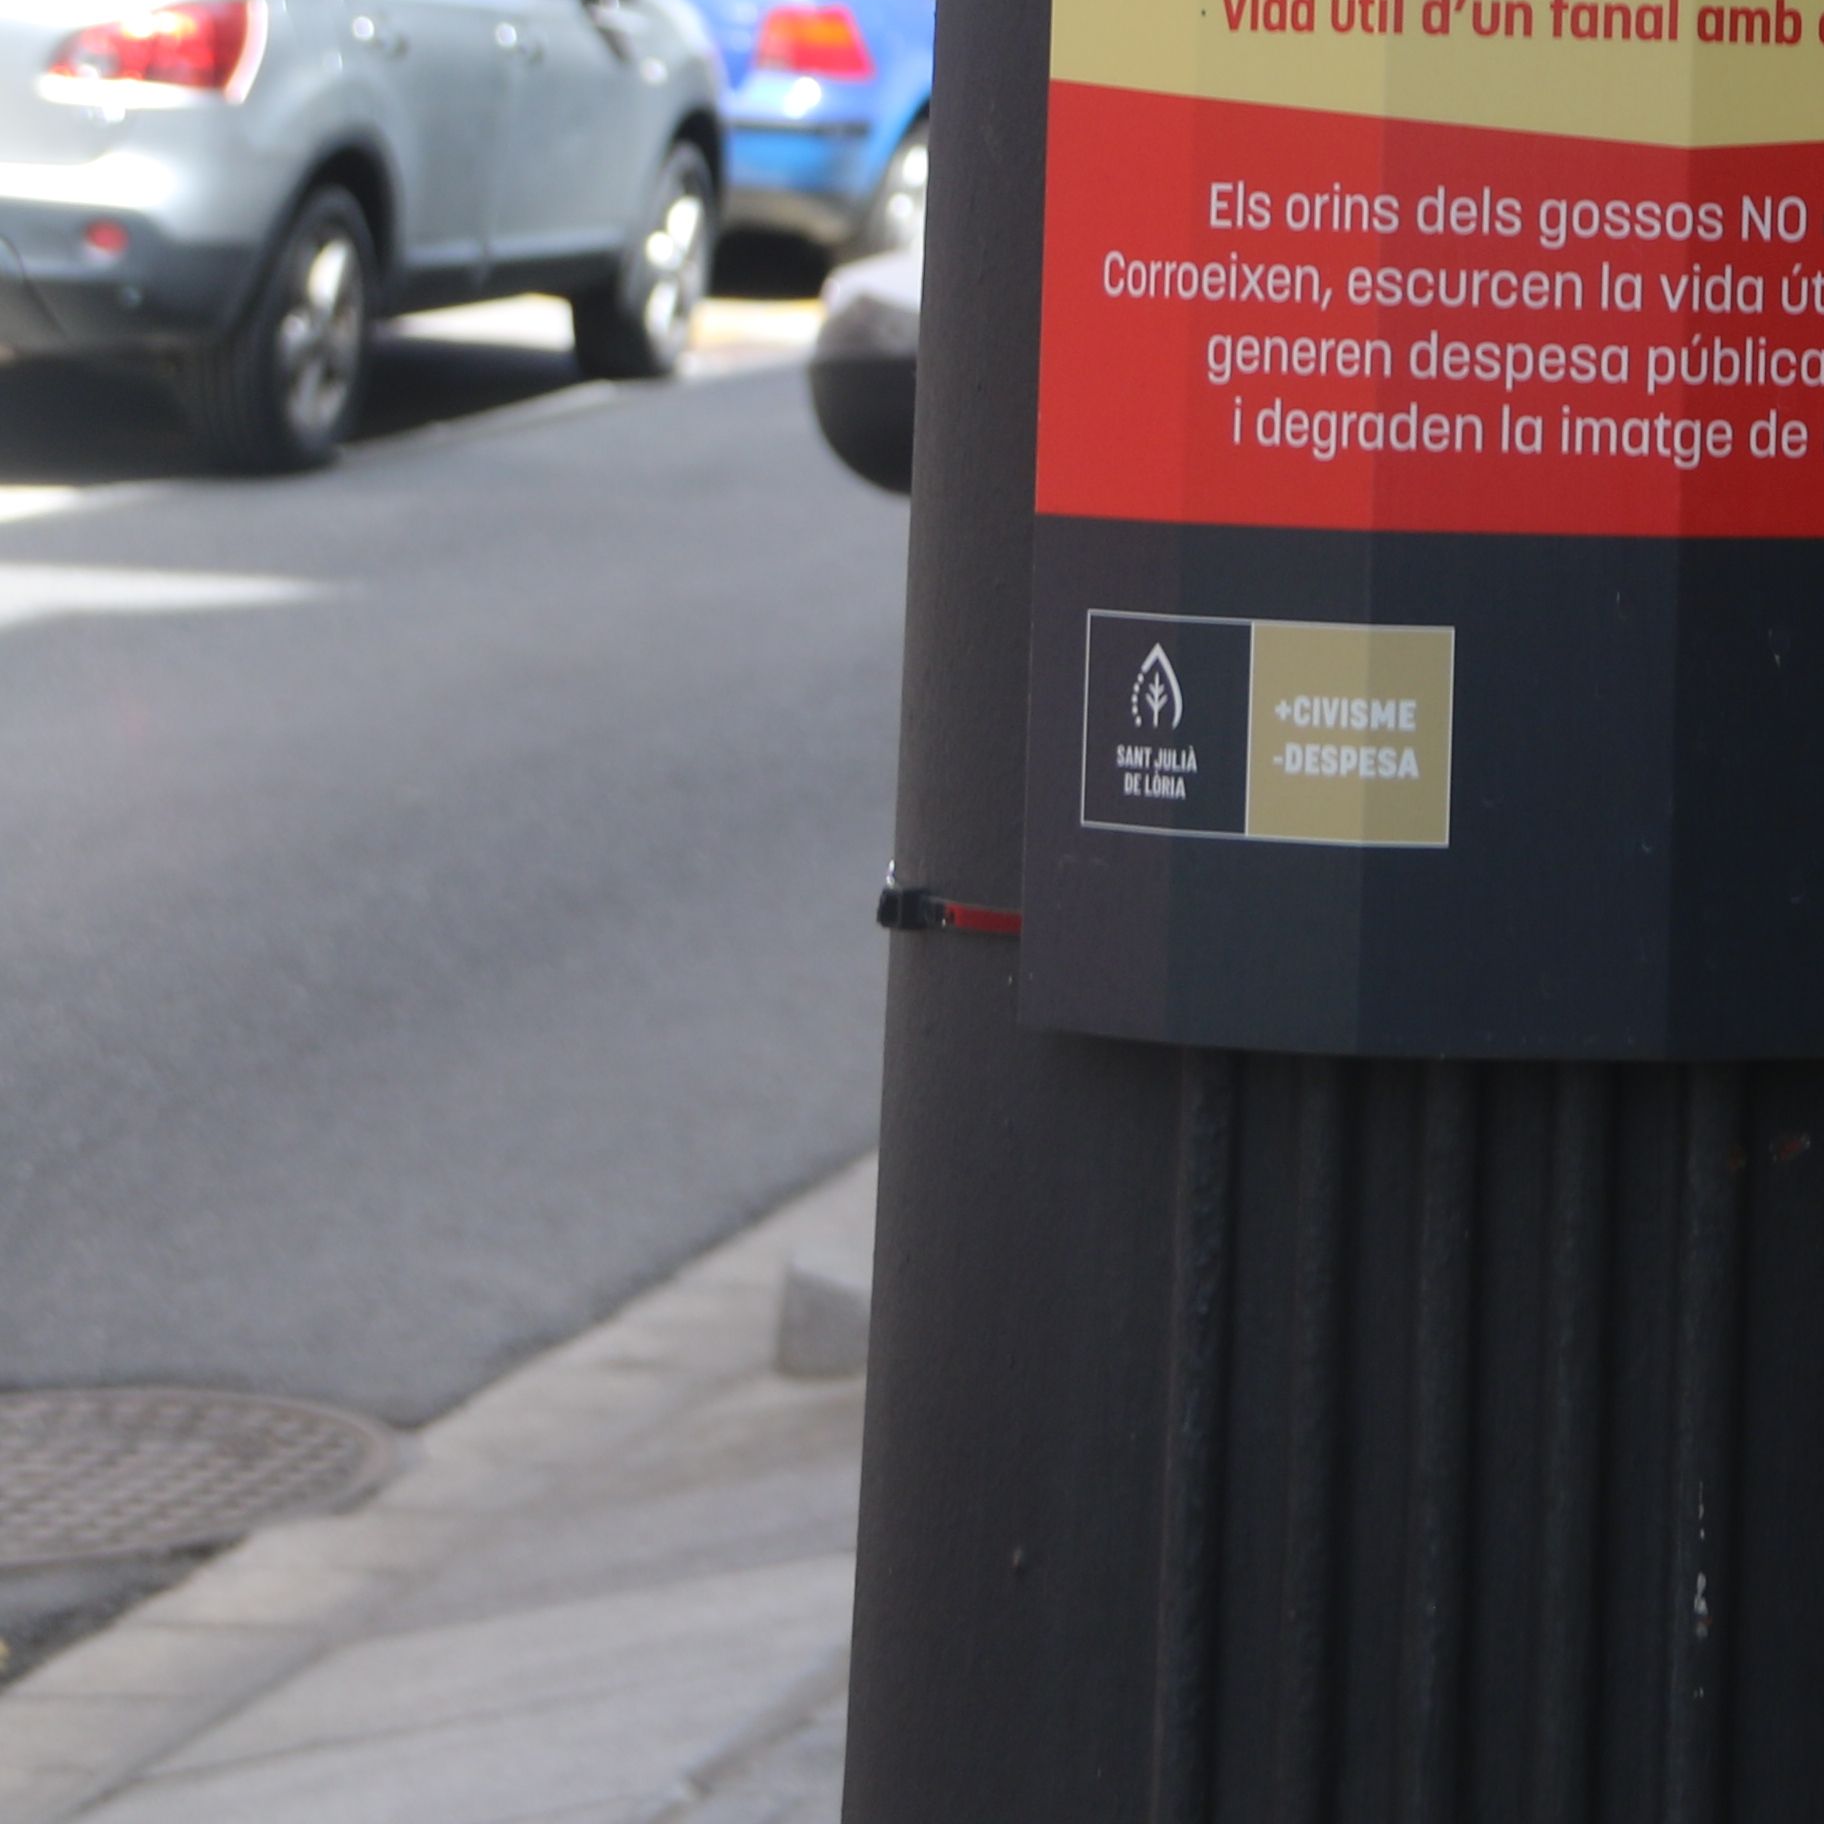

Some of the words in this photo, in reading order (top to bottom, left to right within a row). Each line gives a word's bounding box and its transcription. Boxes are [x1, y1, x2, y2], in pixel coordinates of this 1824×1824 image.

[1208, 180, 1272, 232] Els
[1285, 182, 1401, 235] orins
[1415, 185, 1523, 238] dels
[1538, 198, 1725, 251] gossos
[1740, 194, 1808, 243] NO
[1102, 249, 1334, 311] Corroeixen,
[1347, 265, 1584, 311] escurcen
[1601, 261, 1643, 313] la
[1660, 263, 1764, 314] vida
[1206, 331, 1393, 386] generen
[1408, 330, 1630, 394] despesa
[1231, 396, 1244, 447] i
[1255, 398, 1484, 463] degraden
[1501, 402, 1543, 455] la
[1560, 404, 1734, 470] imatge
[1748, 409, 1809, 459] de
[1273, 694, 1418, 732] +CIVISME
[1116, 743, 1152, 772] SANT
[1153, 745, 1198, 775] JULIÀ
[1272, 742, 1420, 778] -DESPESA
[1123, 773, 1141, 797] DE
[1144, 771, 1187, 801] LÒRIA
